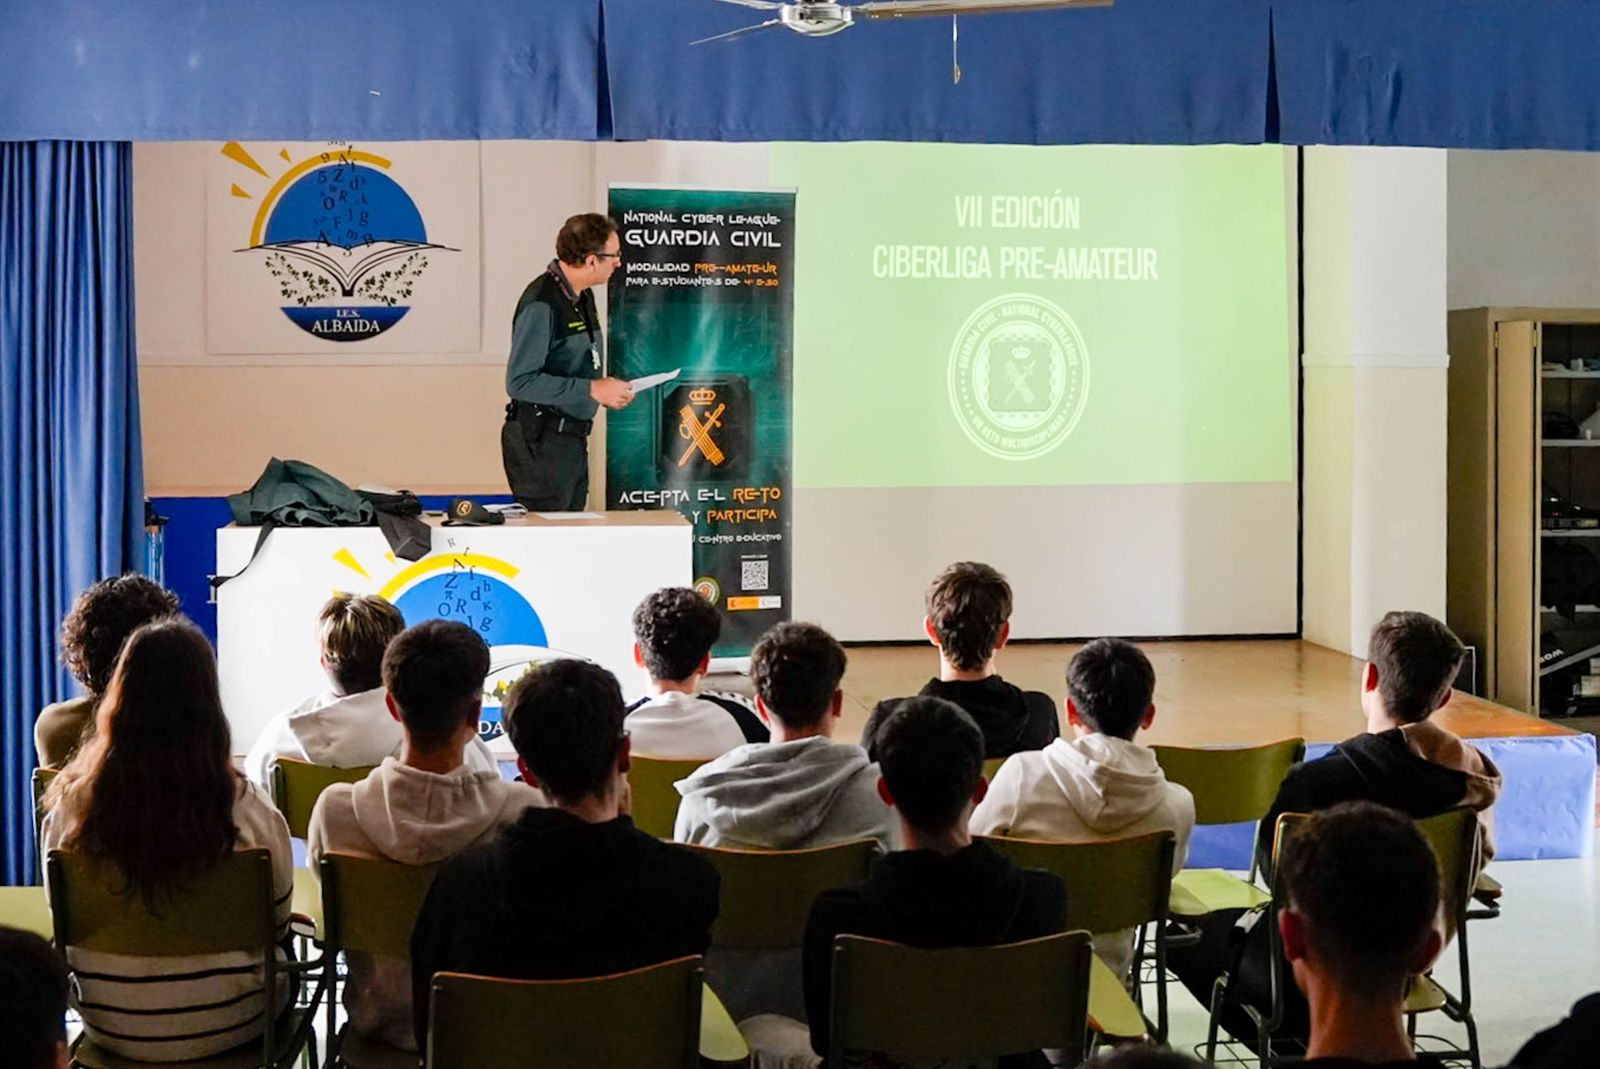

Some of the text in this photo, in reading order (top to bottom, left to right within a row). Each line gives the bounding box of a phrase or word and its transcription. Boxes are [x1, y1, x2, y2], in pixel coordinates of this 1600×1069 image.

[954, 189, 1080, 229] VII EDICIÓN
[623, 210, 781, 227] NATIONAL CYBER LEAGUE
[624, 229, 782, 248] GUARDIA CIVIL
[626, 262, 778, 275] MODALIDAD PRE-AMATEUR
[872, 243, 1159, 280] CIBERLIGA PRE-AMATEUR
[625, 276, 649, 287] PARA
[651, 275, 722, 287] ESTUDIANTES
[725, 278, 741, 286] DE
[311, 319, 381, 334] ALBAIDA
[619, 487, 782, 507] ACEPTA EL RETO
[692, 508, 778, 525] Y PARTICIPA
[698, 532, 734, 545] CENTRO
